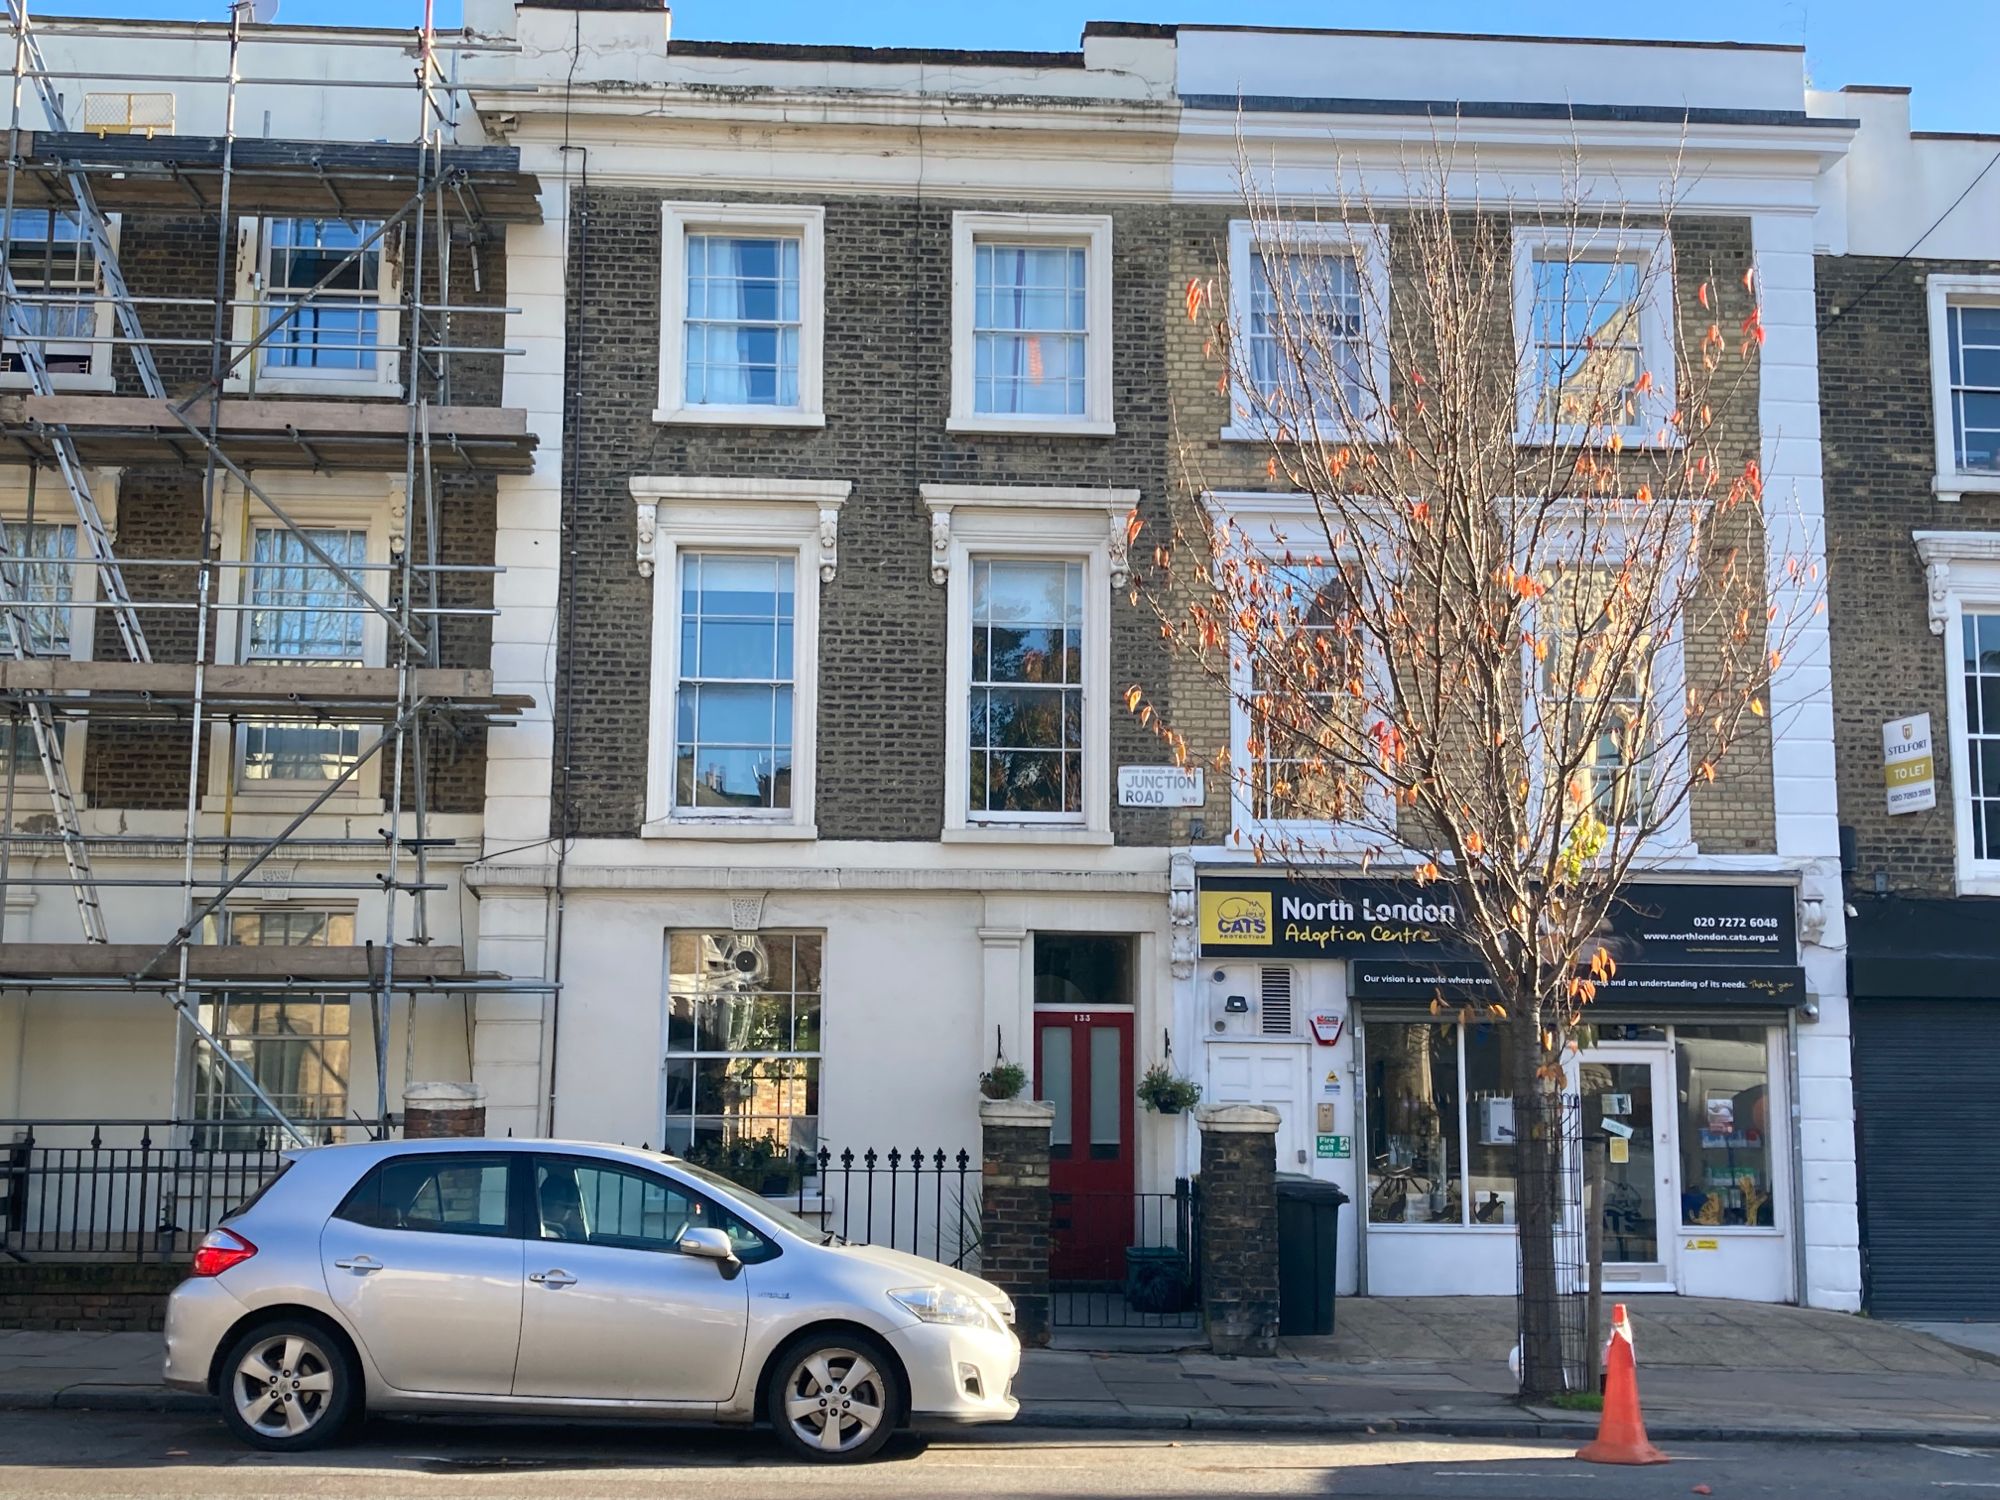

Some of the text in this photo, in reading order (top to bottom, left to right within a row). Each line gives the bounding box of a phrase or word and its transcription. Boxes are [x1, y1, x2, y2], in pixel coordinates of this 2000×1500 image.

[1888, 739, 1928, 756] STELFORT
[1894, 764, 1926, 780] TO LET
[1126, 776, 1197, 789] JUNCTION
[1126, 790, 1164, 803] ROAD
[1282, 896, 1455, 922] North London
[1218, 918, 1266, 933] CATS
[1693, 917, 1778, 928] 020 7272 6048
[1285, 923, 1440, 949] Adoption Centre
[1643, 932, 1779, 943] www.northlondon.cats.org.uk
[1363, 974, 1380, 983] Our
[1381, 974, 1406, 983] vision
[1407, 975, 1414, 983] is
[1422, 975, 1447, 984] world
[1448, 975, 1474, 985] where
[1610, 979, 1626, 987] and
[1640, 979, 1698, 989] understanding
[1699, 980, 1709, 988] of
[1710, 980, 1720, 988] its
[1722, 980, 1748, 989] needs.
[1074, 1014, 1091, 1022] 133
[1319, 1136, 1335, 1144] Fire
